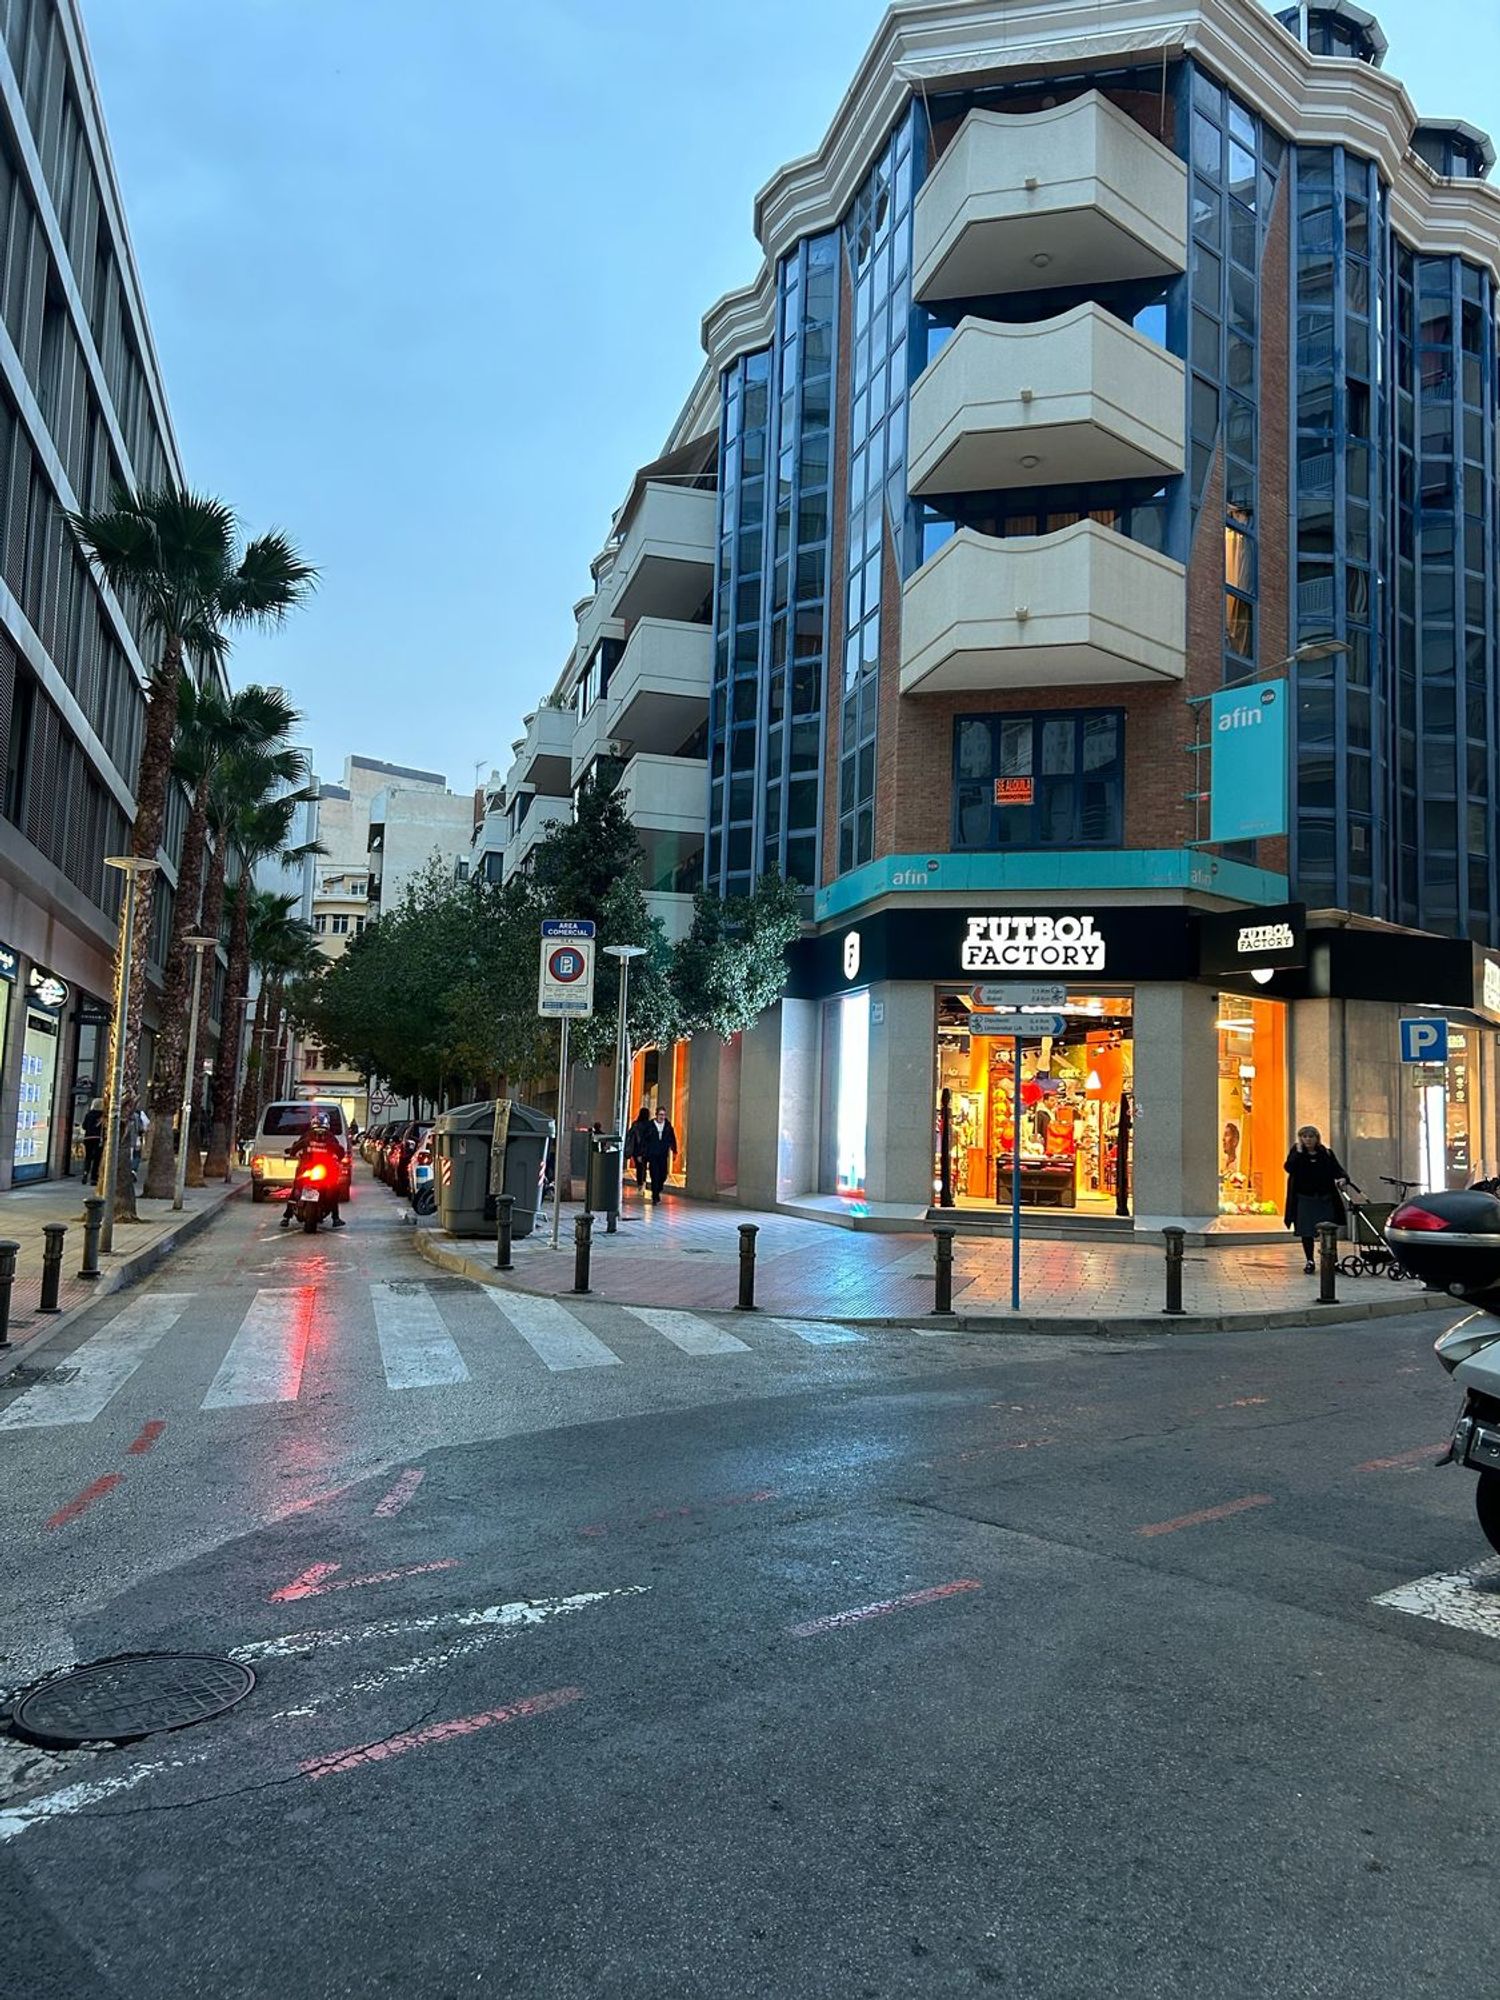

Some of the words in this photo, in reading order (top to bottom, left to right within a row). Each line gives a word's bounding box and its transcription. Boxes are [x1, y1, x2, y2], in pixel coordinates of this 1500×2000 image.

[1218, 706, 1262, 731] afin
[892, 869, 928, 885] afin
[547, 928, 588, 936] COMERCIAL
[967, 916, 1102, 941] FUTBOL
[1239, 923, 1292, 938] FUTBOL
[1239, 936, 1291, 950] FACTORY
[967, 945, 1100, 965] FACTORY
[1409, 1024, 1438, 1058] P
